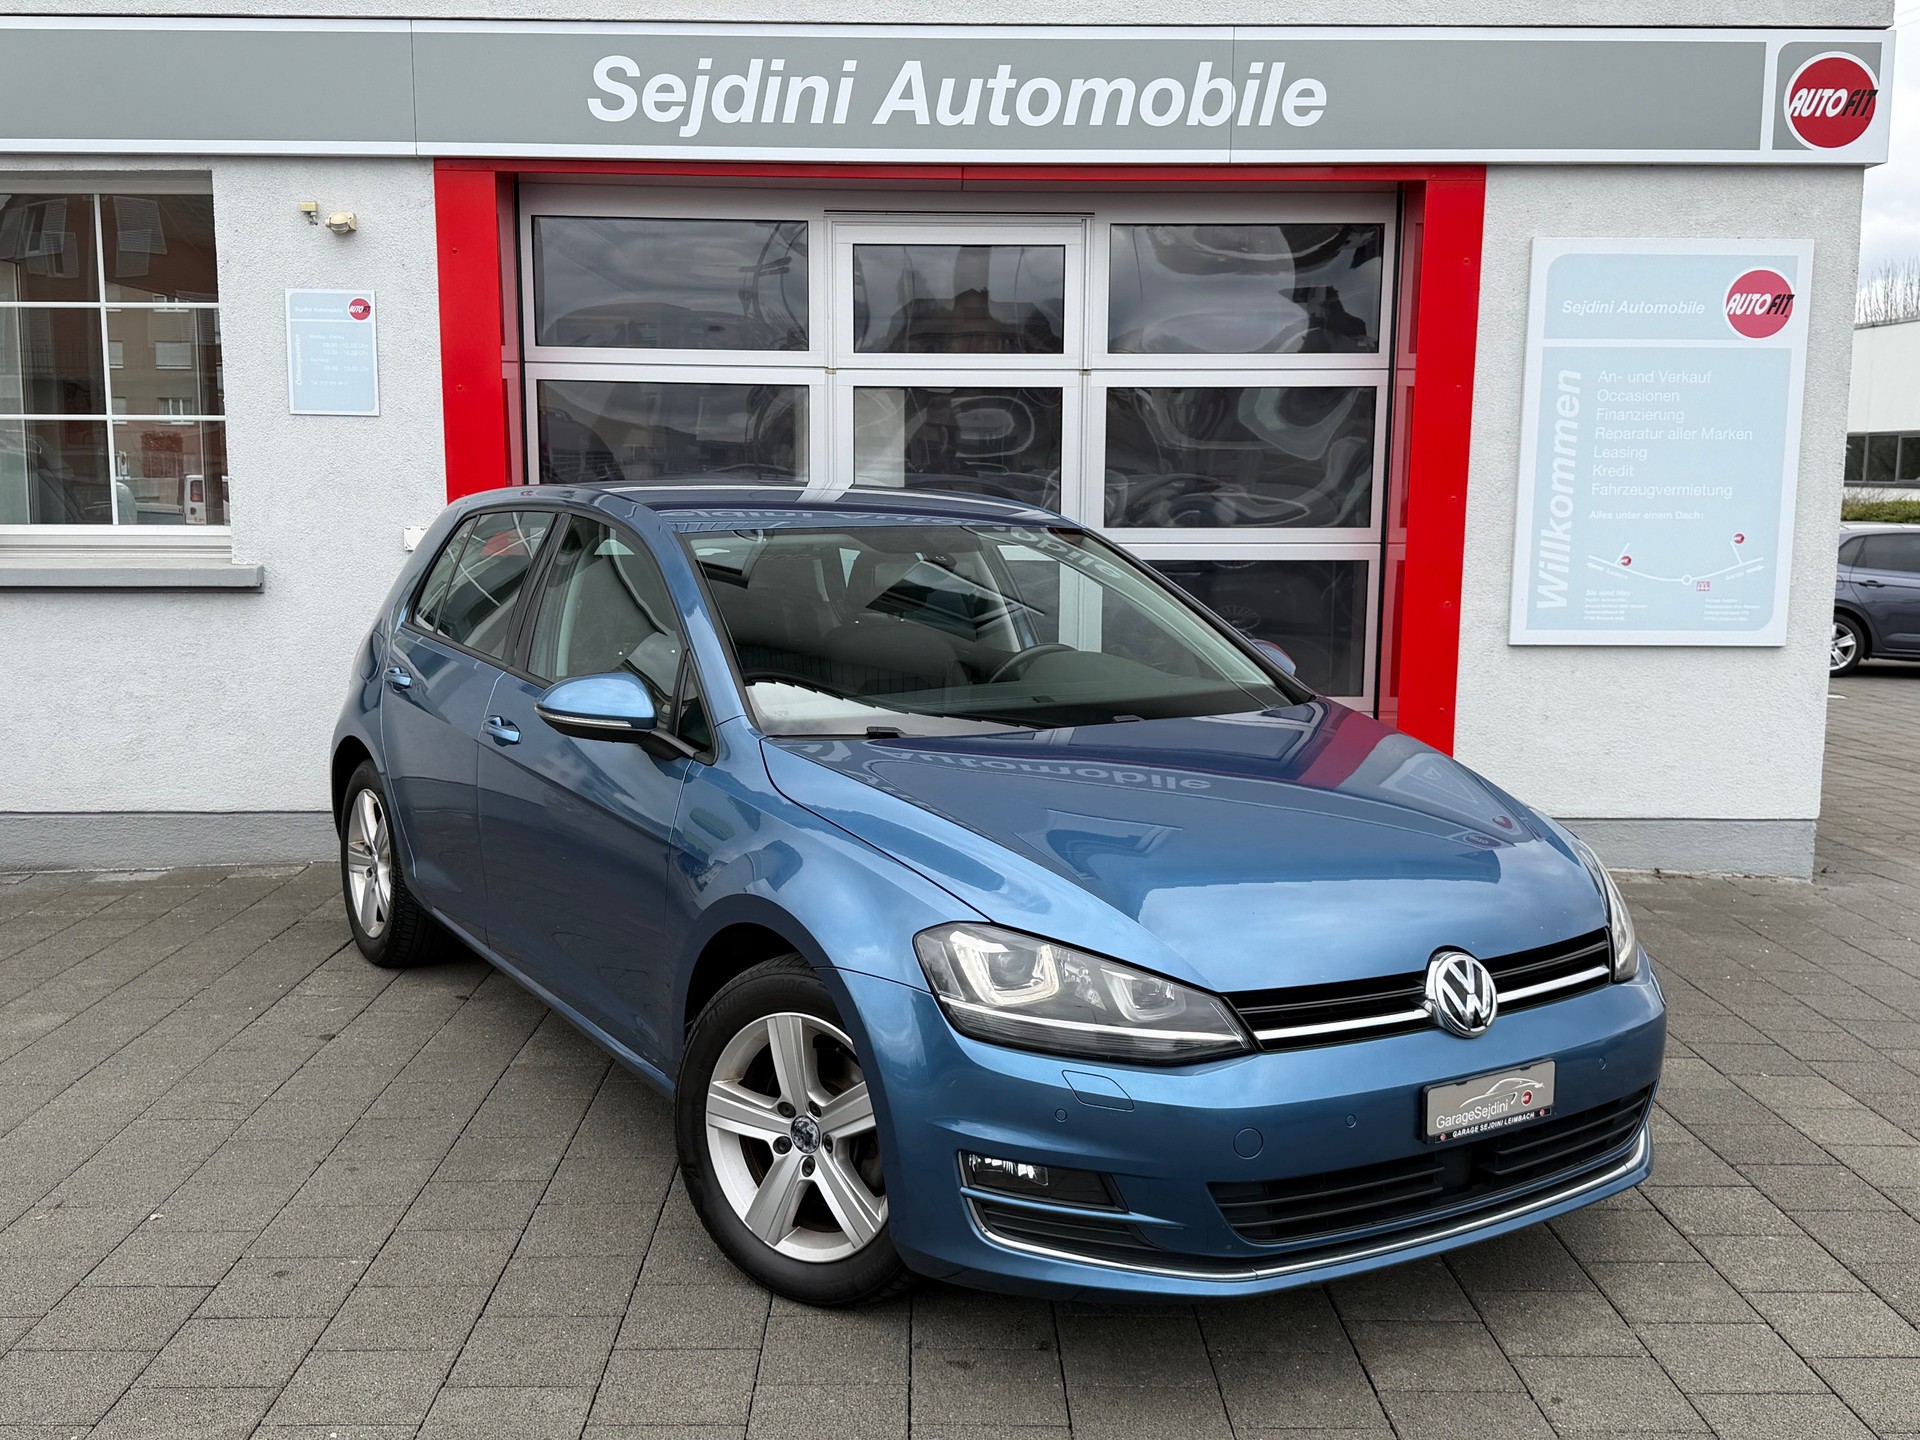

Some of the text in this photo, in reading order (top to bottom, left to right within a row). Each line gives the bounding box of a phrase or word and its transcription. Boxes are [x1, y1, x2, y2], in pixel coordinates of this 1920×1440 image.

[587, 55, 1328, 138] Sejdini Automobile
[1789, 88, 1879, 118] AUTOFIT
[1561, 300, 1705, 317] Sejdini Automobile
[1725, 293, 1795, 316] AUTOFIT
[1597, 370, 1713, 383] An- und Verkauf
[1597, 389, 1680, 402] Occasionen
[1595, 407, 1685, 424] Finanzierung
[1594, 426, 1753, 441] Reparatur aller Marken
[1594, 446, 1648, 461] Leasing
[1592, 464, 1634, 477] Kredit
[1537, 369, 1582, 608] Willkommen
[1591, 483, 1733, 500] Fahrzeugvermietung
[1589, 511, 1613, 520] Alles
[1615, 512, 1641, 520] unter
[1643, 511, 1673, 520] einem
[1436, 1099, 1509, 1128] GarageSejdini
[1452, 1112, 1535, 1138] GARAGE SEJDINI LEIMBACH
